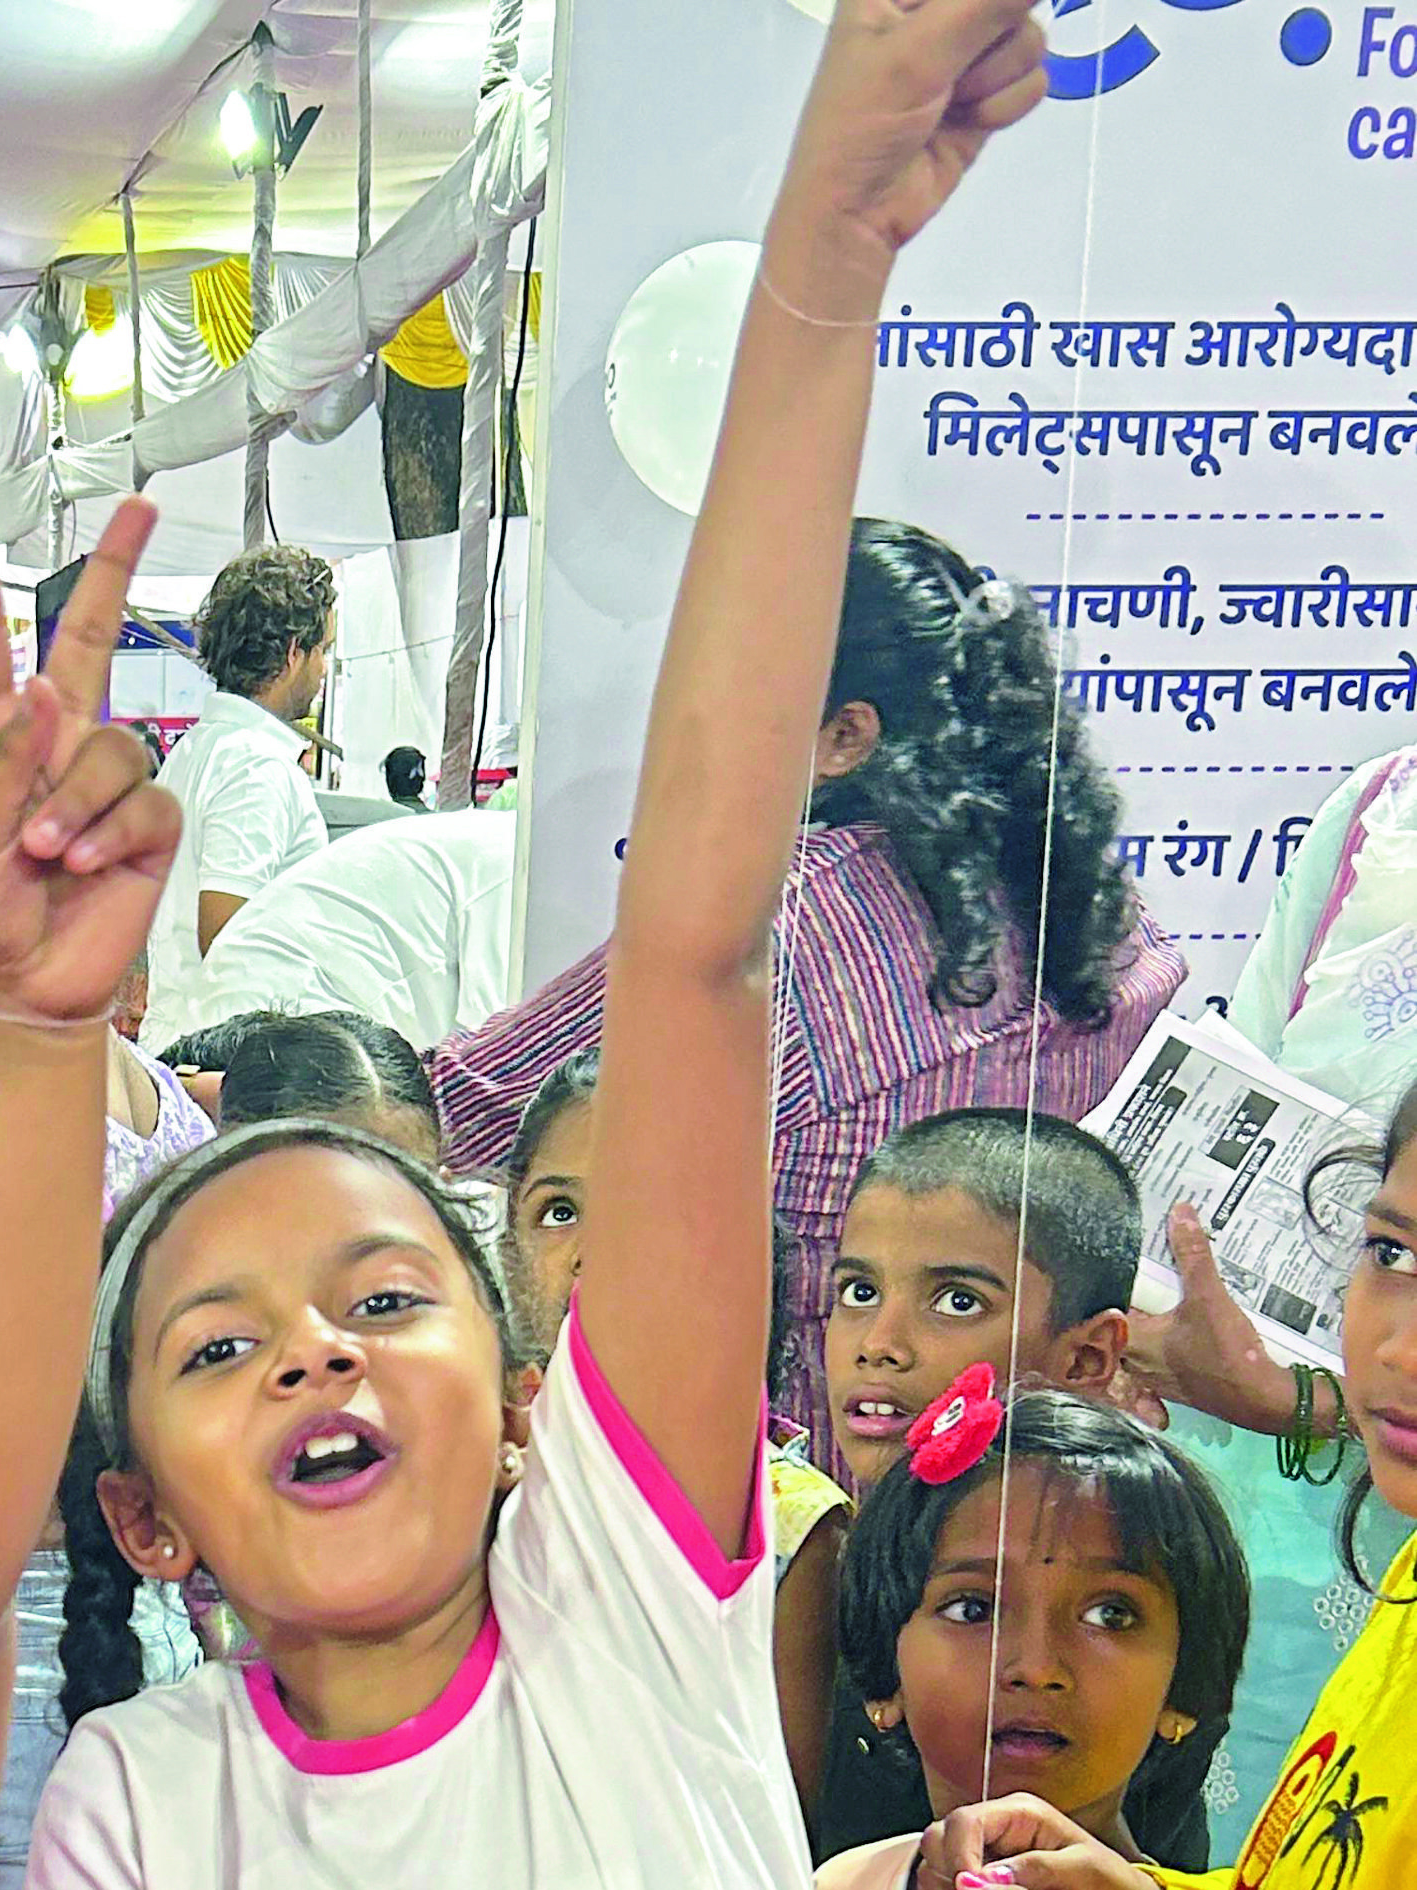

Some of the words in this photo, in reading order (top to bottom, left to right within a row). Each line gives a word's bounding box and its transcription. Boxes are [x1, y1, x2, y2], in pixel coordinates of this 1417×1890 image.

[877, 301, 1041, 368] ांसाठी
[1049, 321, 1176, 368] खास
[1184, 301, 1417, 376] आरोग्यदा
[923, 390, 1259, 477] मिलेट्सपासून
[1218, 564, 1417, 629] ज्वारीसा
[1162, 819, 1232, 878] रंग
